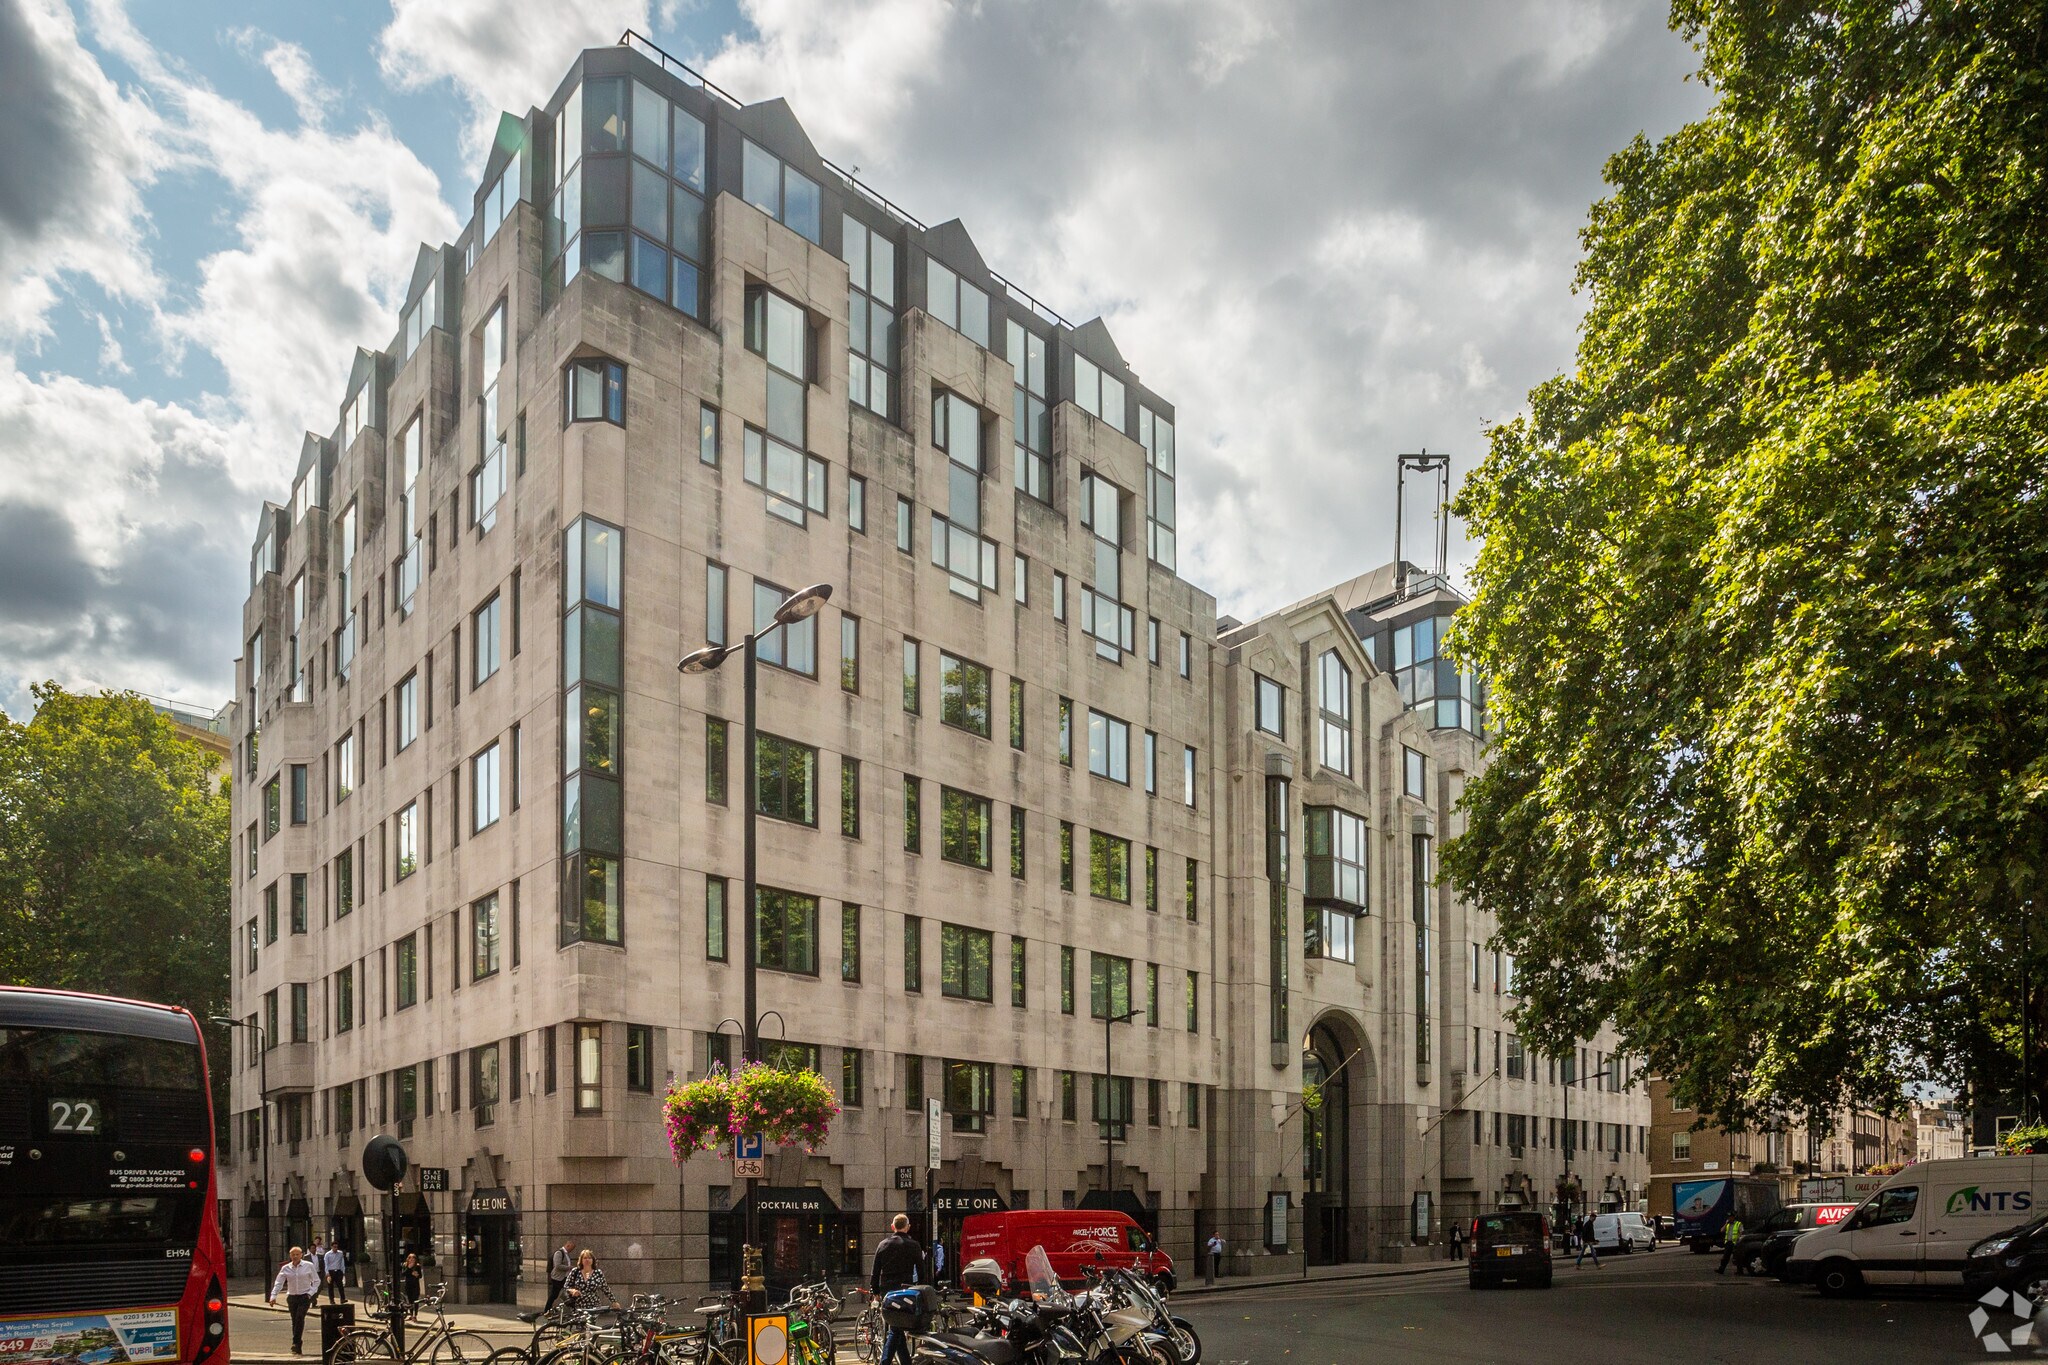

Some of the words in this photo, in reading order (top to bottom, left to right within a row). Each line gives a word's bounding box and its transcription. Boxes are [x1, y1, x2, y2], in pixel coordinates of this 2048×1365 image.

[52, 1102, 95, 1131] 22
[423, 1182, 441, 1190] BAR
[472, 1199, 480, 1210] BE
[482, 1198, 490, 1209] AT
[491, 1198, 507, 1210] ONE
[802, 1201, 819, 1210] BAR
[938, 1198, 952, 1209] BE
[957, 1198, 969, 1209] AT
[973, 1198, 998, 1209] ONE
[1951, 1190, 2032, 1213] ANTS
[1818, 1208, 1851, 1219] AVIS
[1093, 1226, 1118, 1237] FORCE
[1098, 1236, 1120, 1244] WORLDWIDE
[166, 1249, 191, 1258] EH94
[51, 1320, 74, 1328] Seyahi
[34, 1341, 52, 1349] 35%
[129, 1346, 153, 1356] DUBAI
